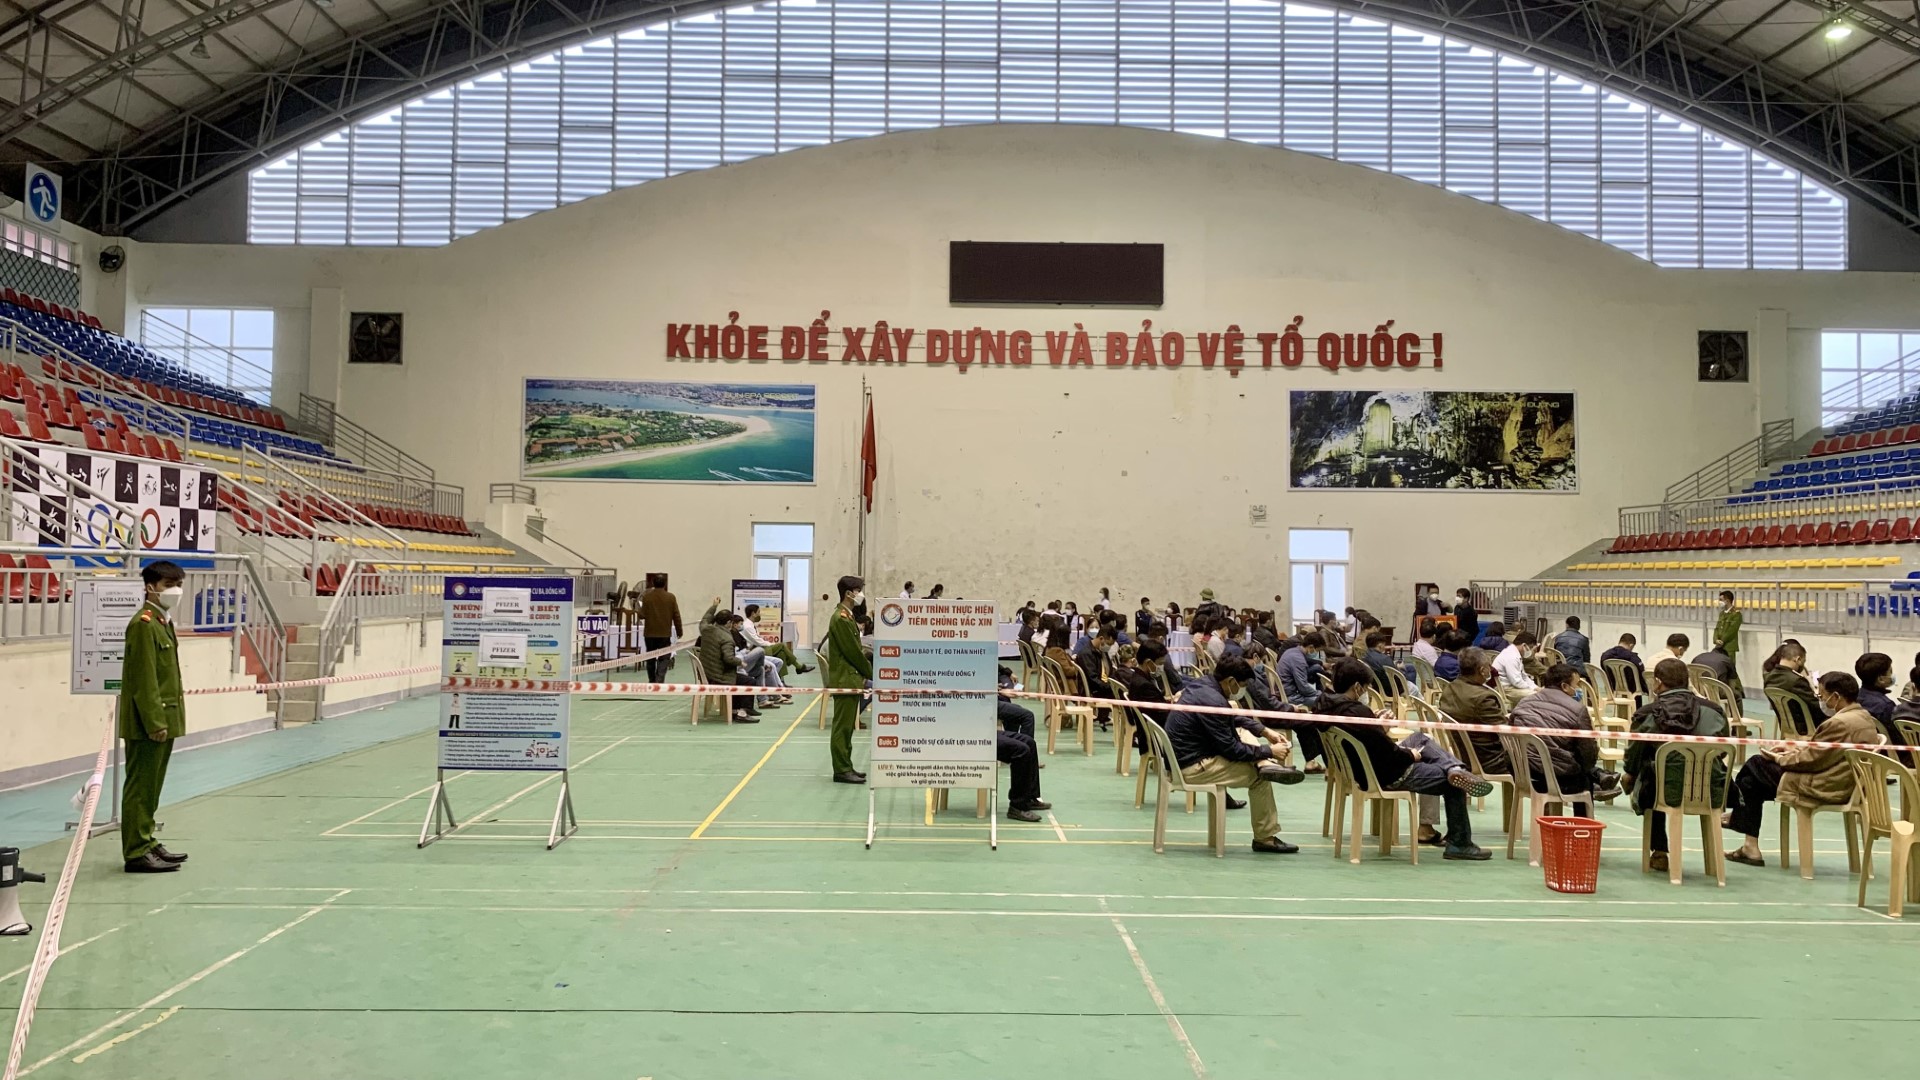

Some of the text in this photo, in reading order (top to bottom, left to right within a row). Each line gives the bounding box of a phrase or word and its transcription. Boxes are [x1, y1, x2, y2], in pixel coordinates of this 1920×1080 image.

[667, 310, 769, 360] KHỎE
[781, 309, 830, 361] ĐỂ
[842, 319, 915, 363] XÂY
[926, 326, 1032, 374] DỰNG
[1045, 322, 1094, 367] VÀ
[1106, 318, 1185, 367] BẢO
[1197, 324, 1245, 378] VỆ
[1257, 314, 1304, 369] TỔ
[1317, 319, 1421, 374] QUỐC
[453, 603, 561, 612] NHỮN BIẾT
[907, 604, 994, 616] QUY TRÌNH THỰC HIỆN
[578, 616, 608, 631] LỐI VÀO
[908, 614, 992, 626] TIÊM CHỦNG VẮC XIN
[931, 629, 968, 638] COVID-19
[894, 670, 899, 678] 2
[893, 715, 898, 723] 4
